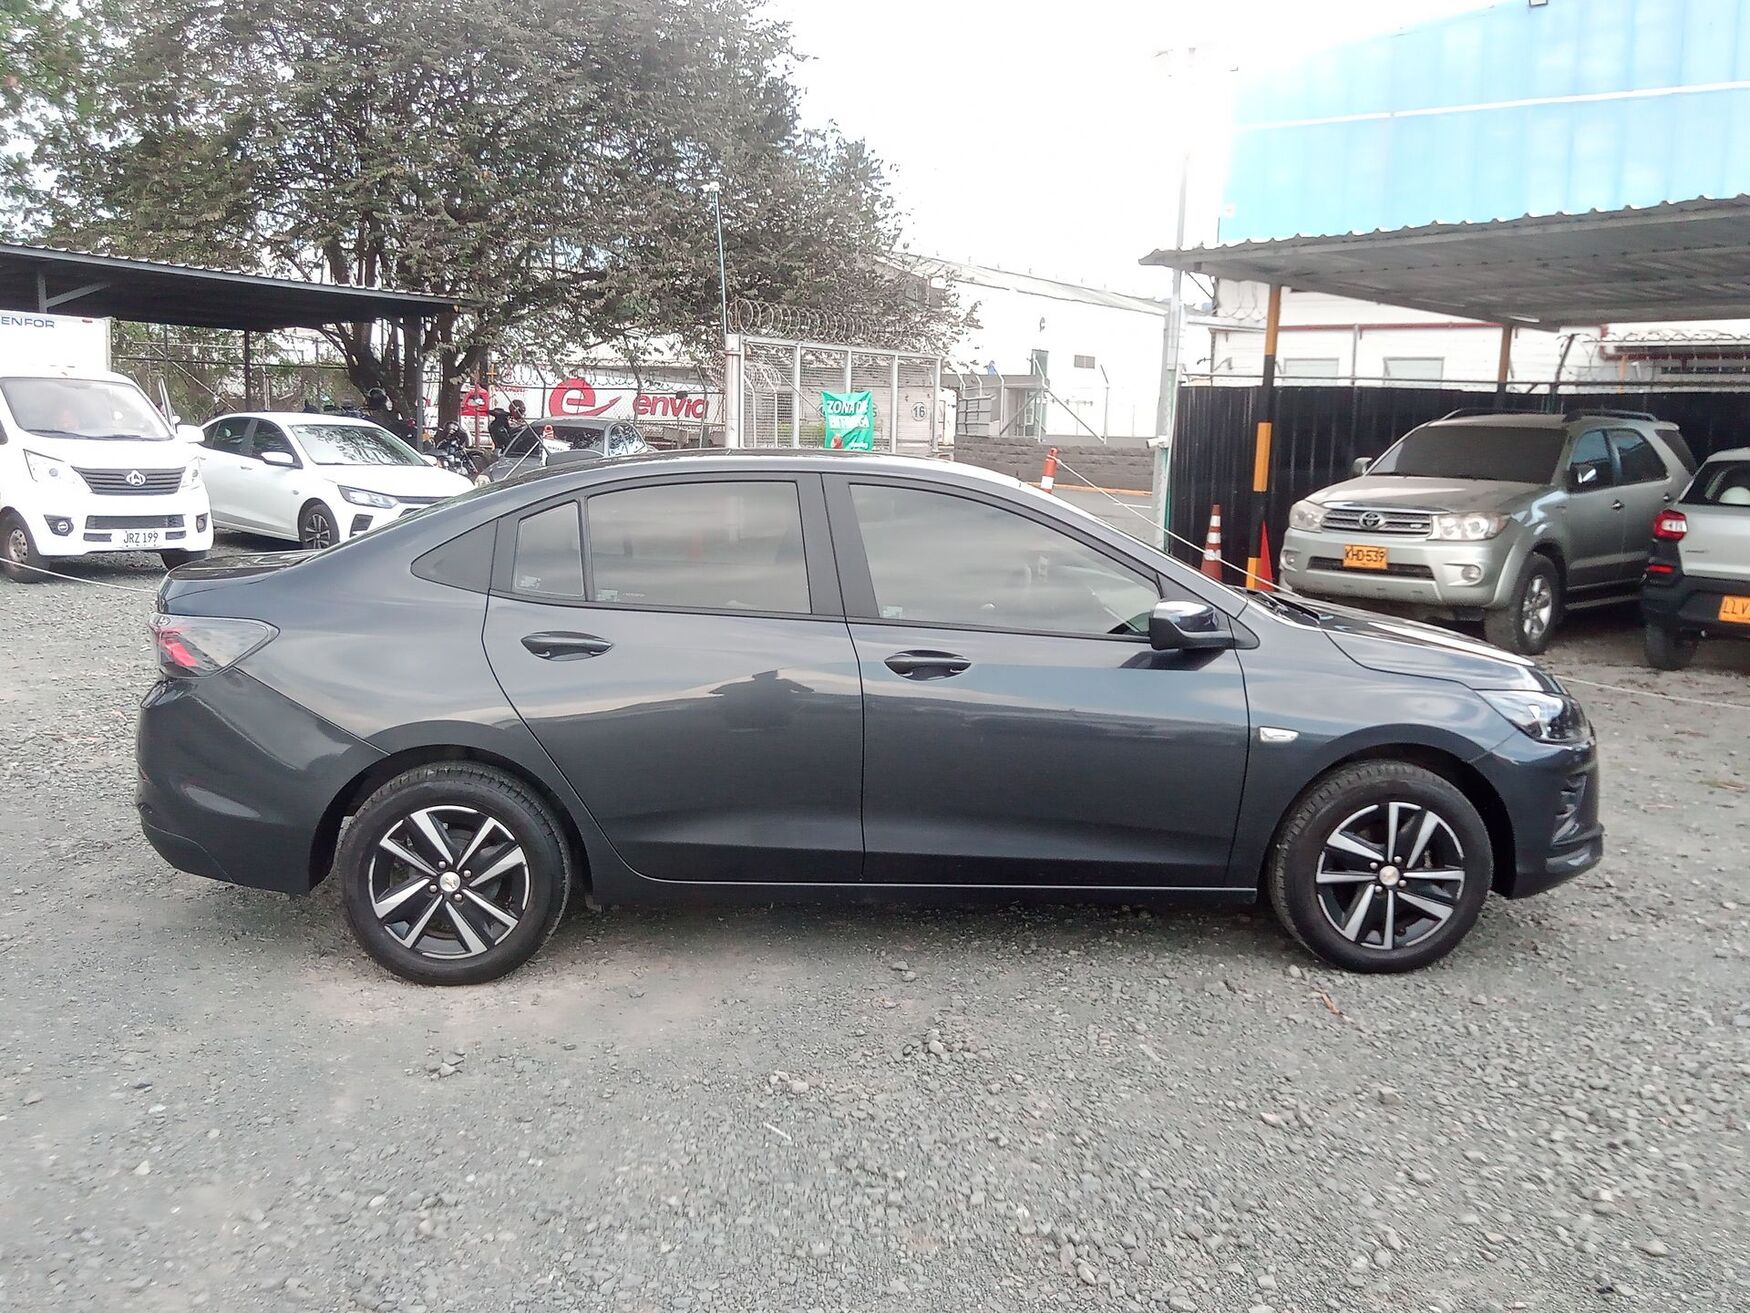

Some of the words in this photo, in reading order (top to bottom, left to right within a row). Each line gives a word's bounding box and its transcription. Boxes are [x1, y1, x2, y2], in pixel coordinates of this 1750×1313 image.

[913, 406, 925, 418] 16
[123, 533, 140, 544] JRZ
[142, 532, 159, 543] 199
